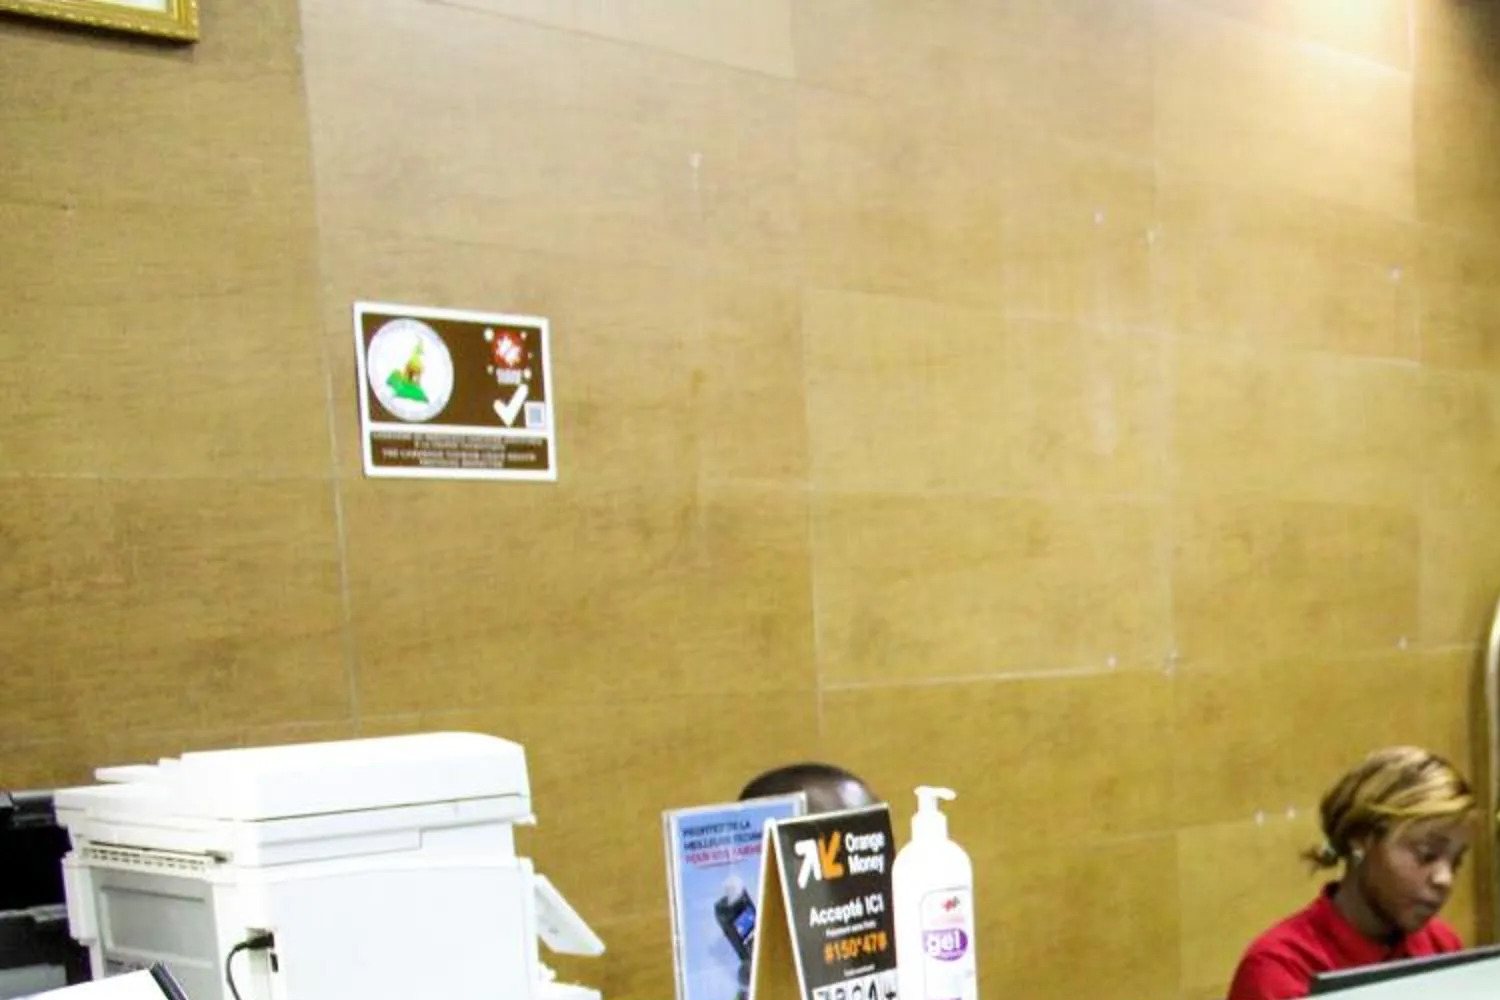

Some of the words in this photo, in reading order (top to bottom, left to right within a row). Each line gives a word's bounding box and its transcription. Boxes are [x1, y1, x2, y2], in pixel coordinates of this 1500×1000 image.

[845, 832, 885, 853] Orange
[848, 854, 885, 875] Money
[927, 931, 961, 958] gel
